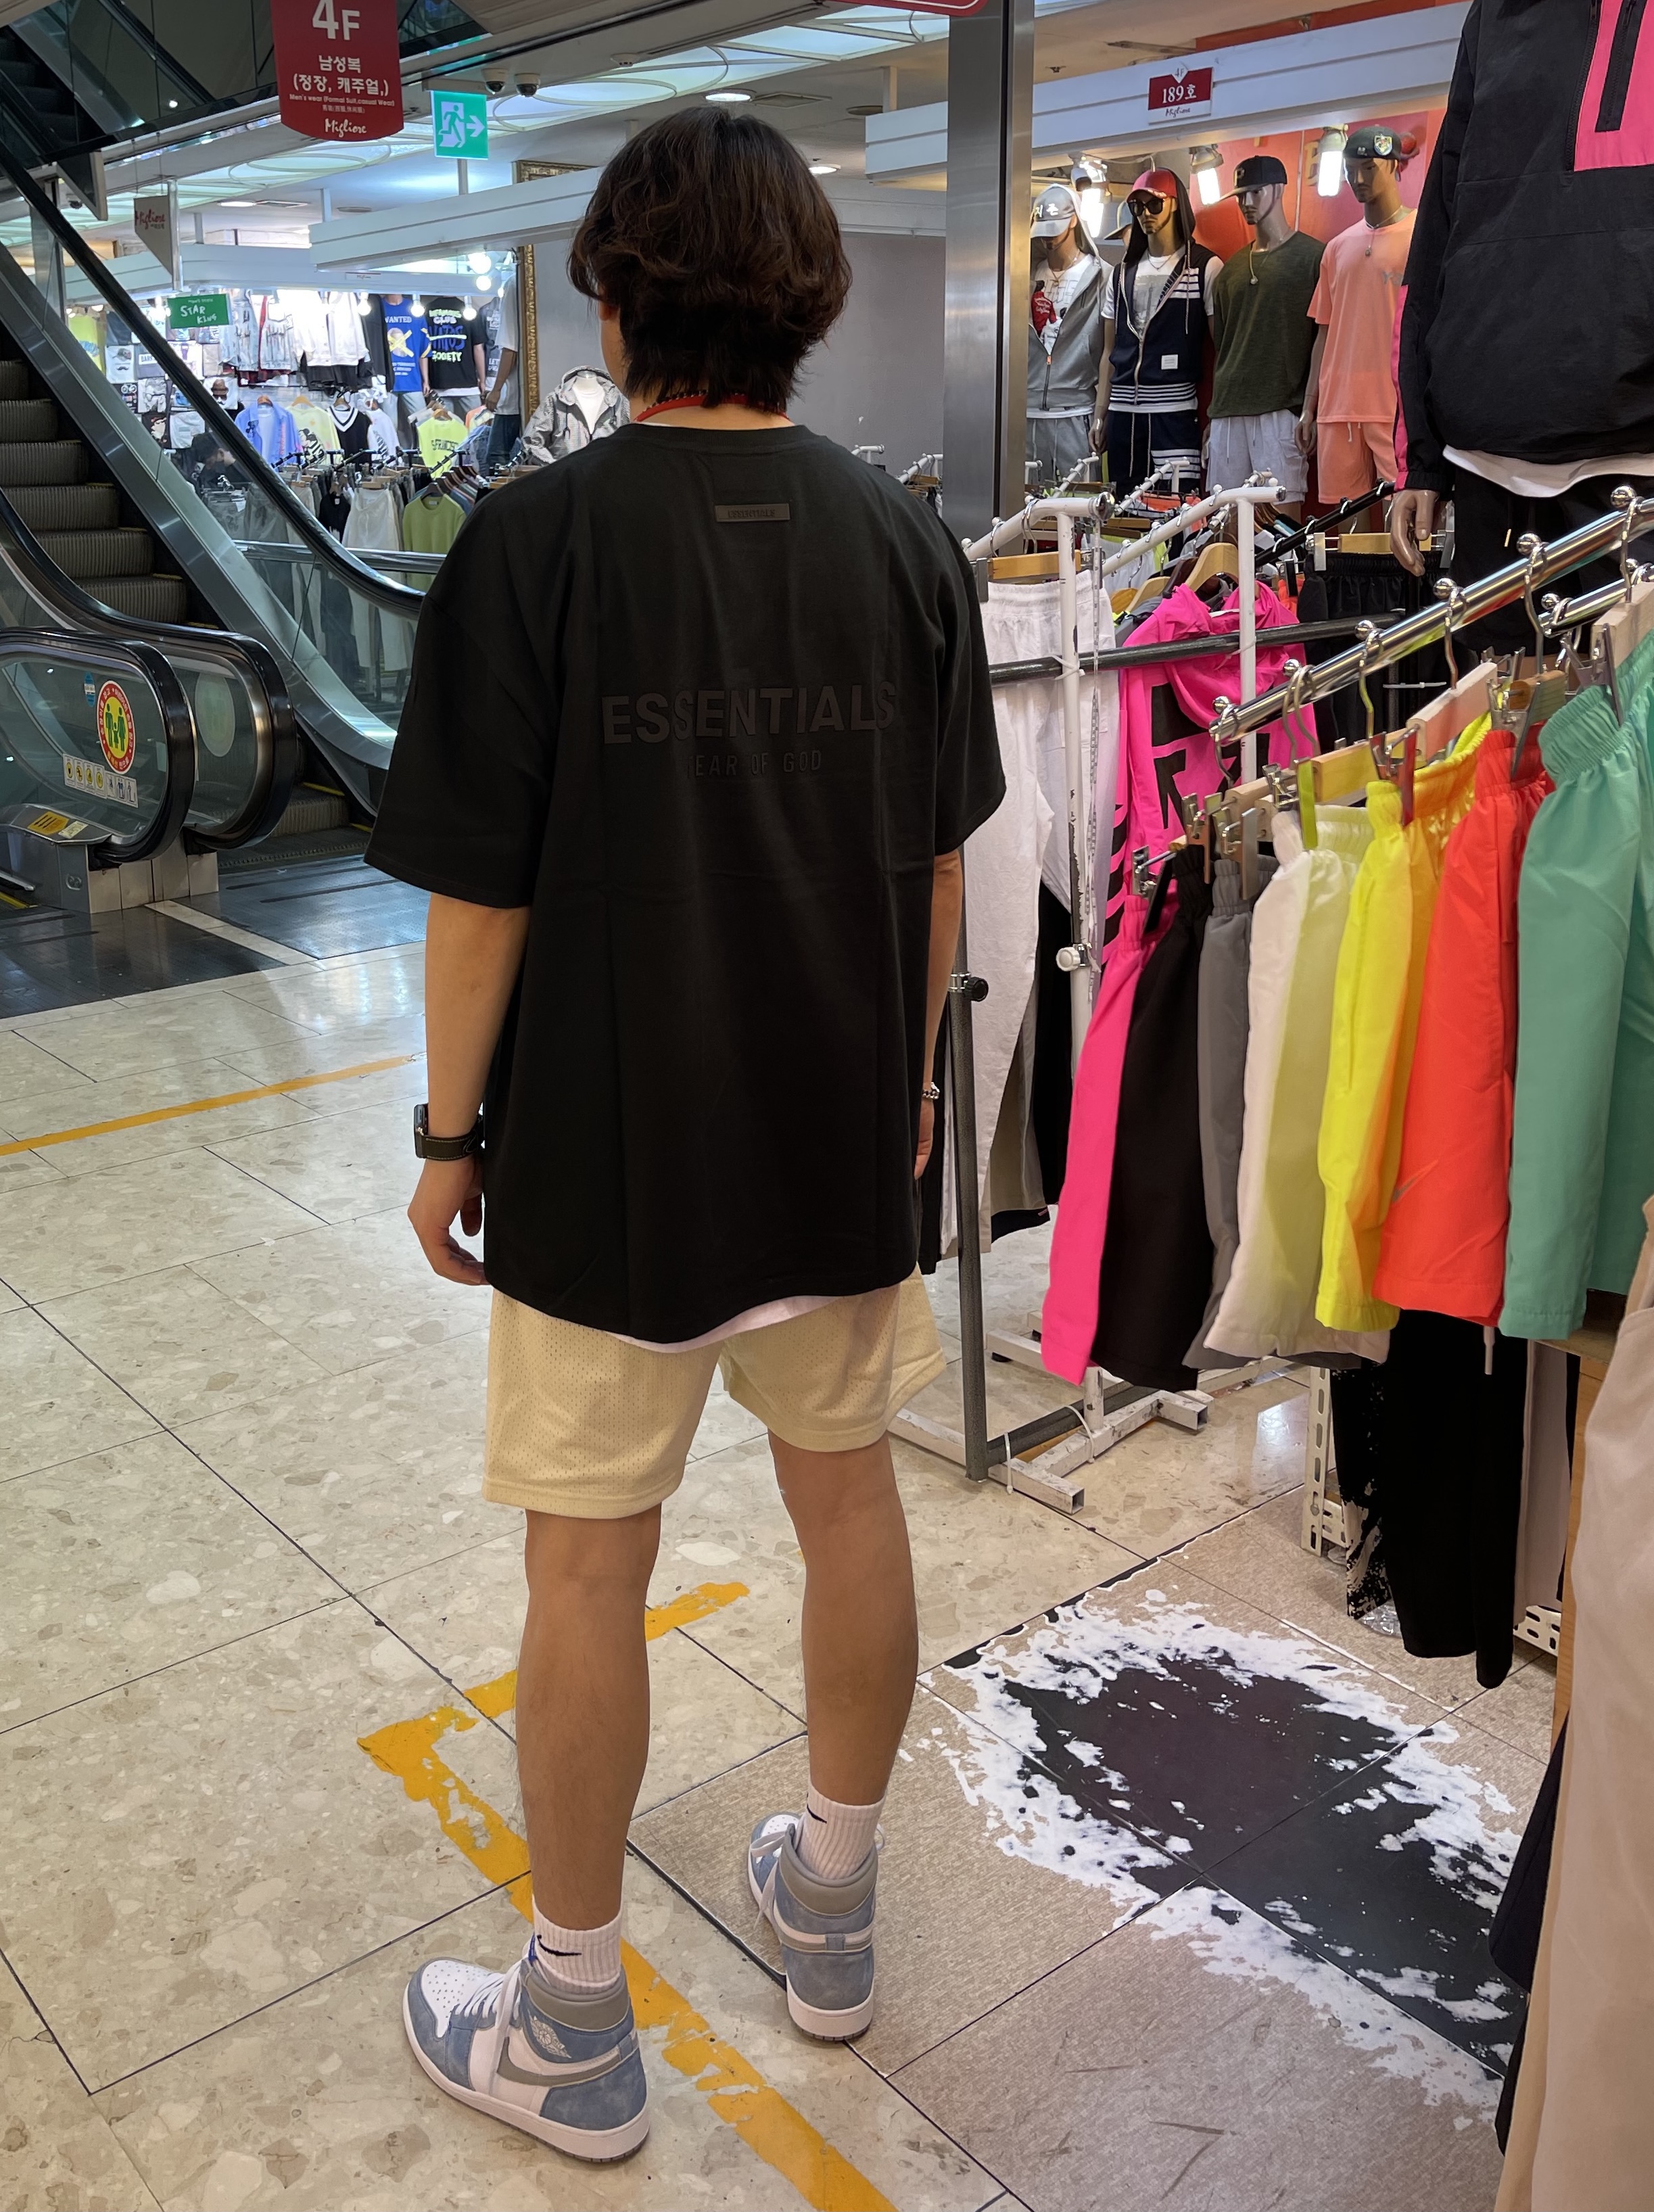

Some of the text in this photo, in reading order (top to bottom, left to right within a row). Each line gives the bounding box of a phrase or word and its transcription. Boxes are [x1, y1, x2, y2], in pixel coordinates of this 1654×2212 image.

[312, 0, 360, 41] 4F
[318, 55, 361, 74] 남성복
[293, 73, 332, 93] (정장,
[1162, 84, 1197, 103] 189호
[325, 118, 367, 138] Migliore
[180, 304, 206, 317] STAR
[728, 507, 776, 519] ESSENTIALS
[602, 682, 897, 744] ESSENTIALS
[751, 752, 770, 775] OF
[783, 749, 822, 773] GOD
